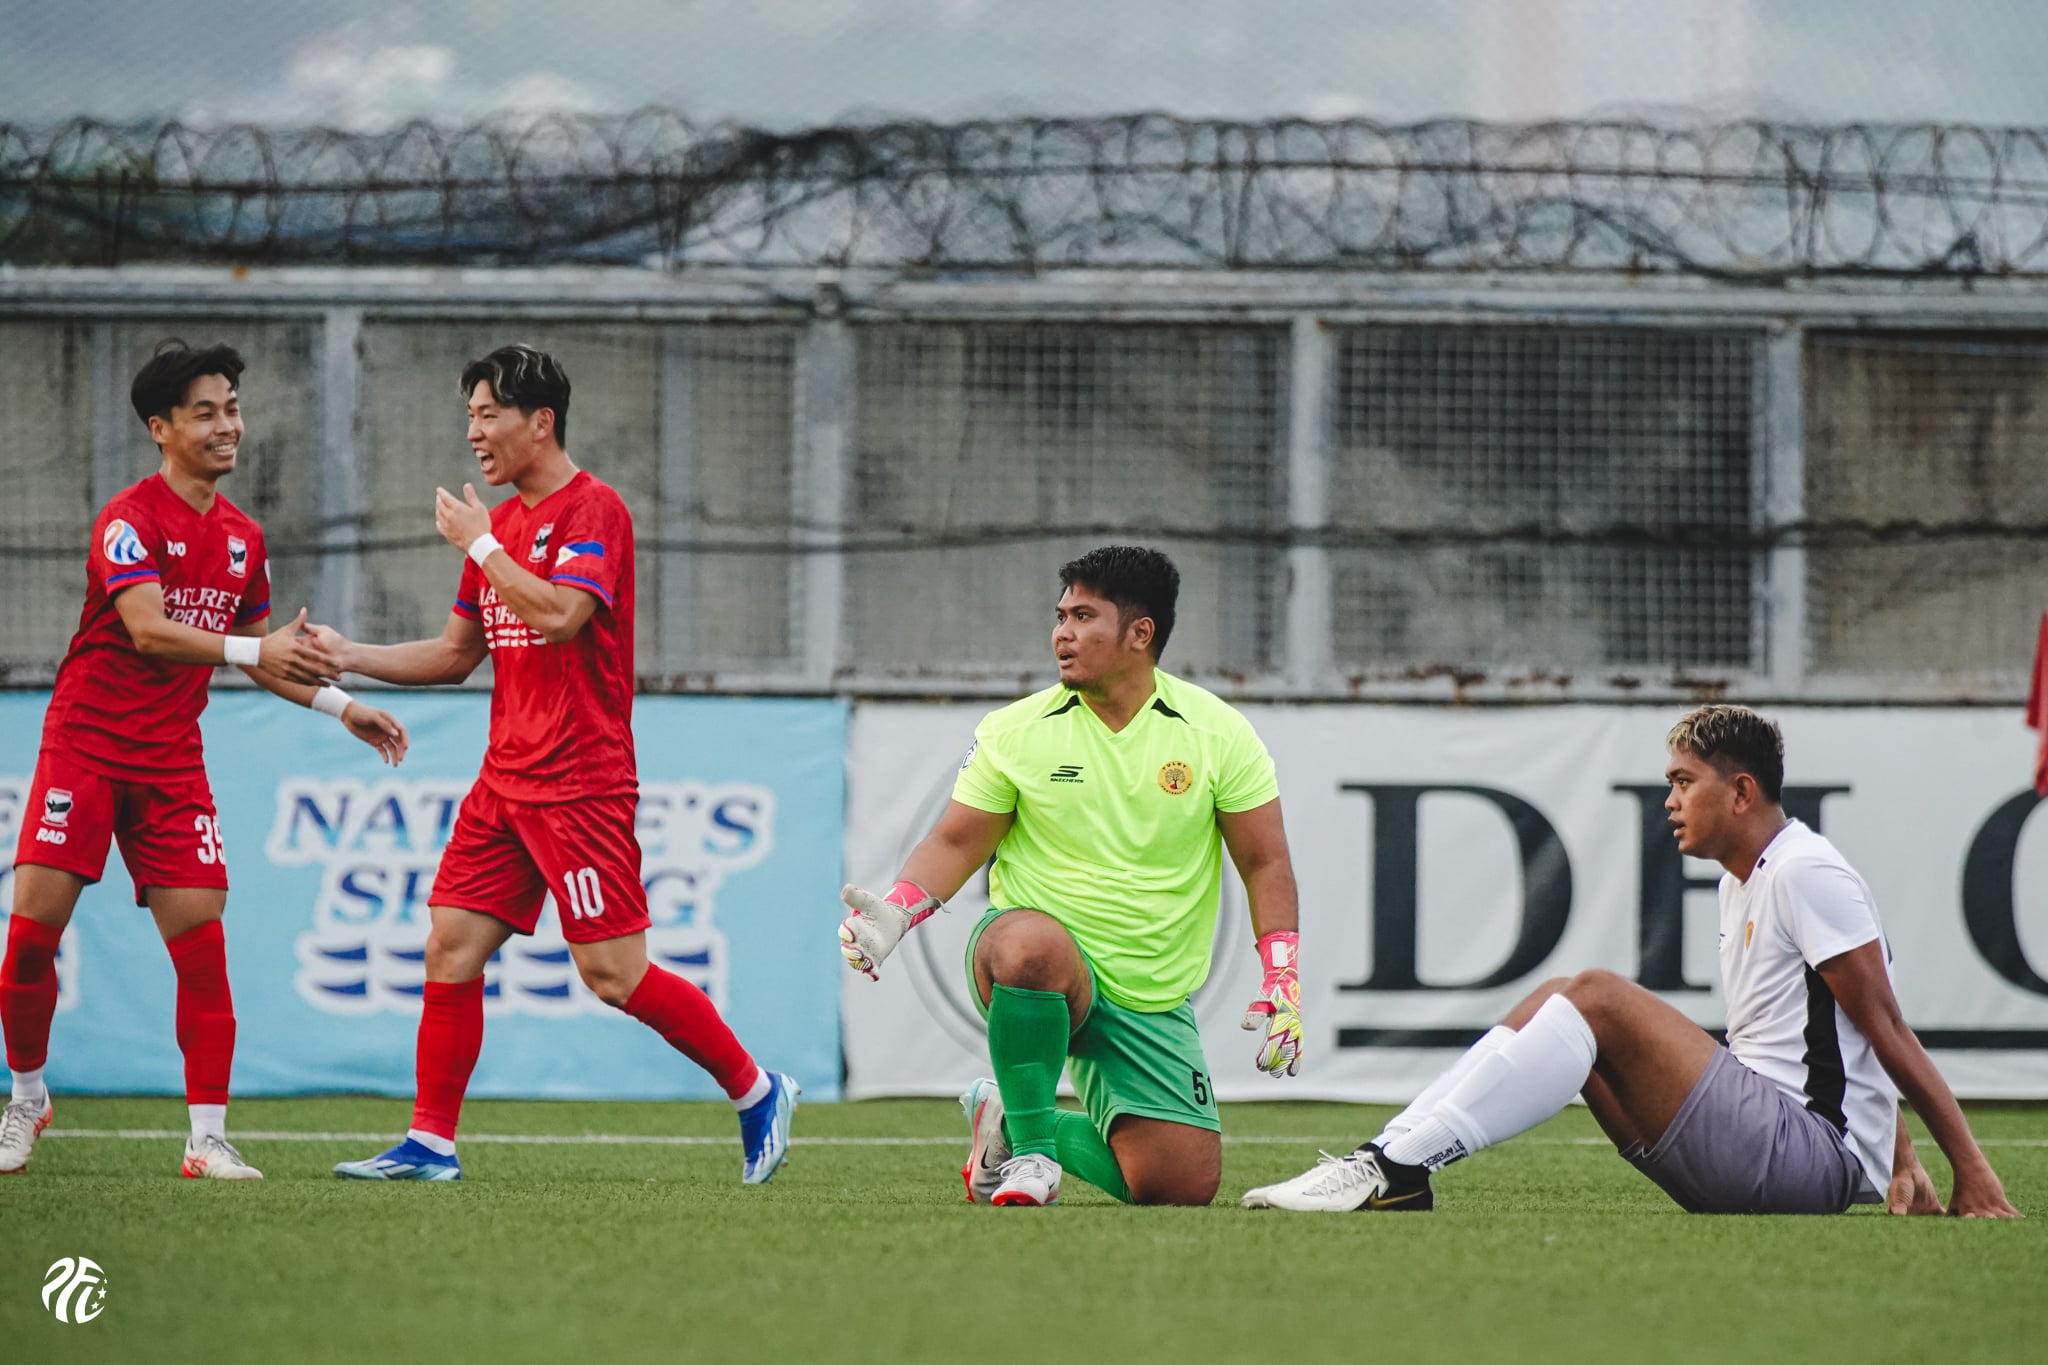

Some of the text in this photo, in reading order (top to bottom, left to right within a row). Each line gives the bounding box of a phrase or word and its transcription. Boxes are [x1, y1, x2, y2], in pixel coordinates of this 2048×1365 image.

[36, 827, 67, 845] RAD
[286, 791, 761, 857] NATE'S
[564, 866, 605, 920] 10
